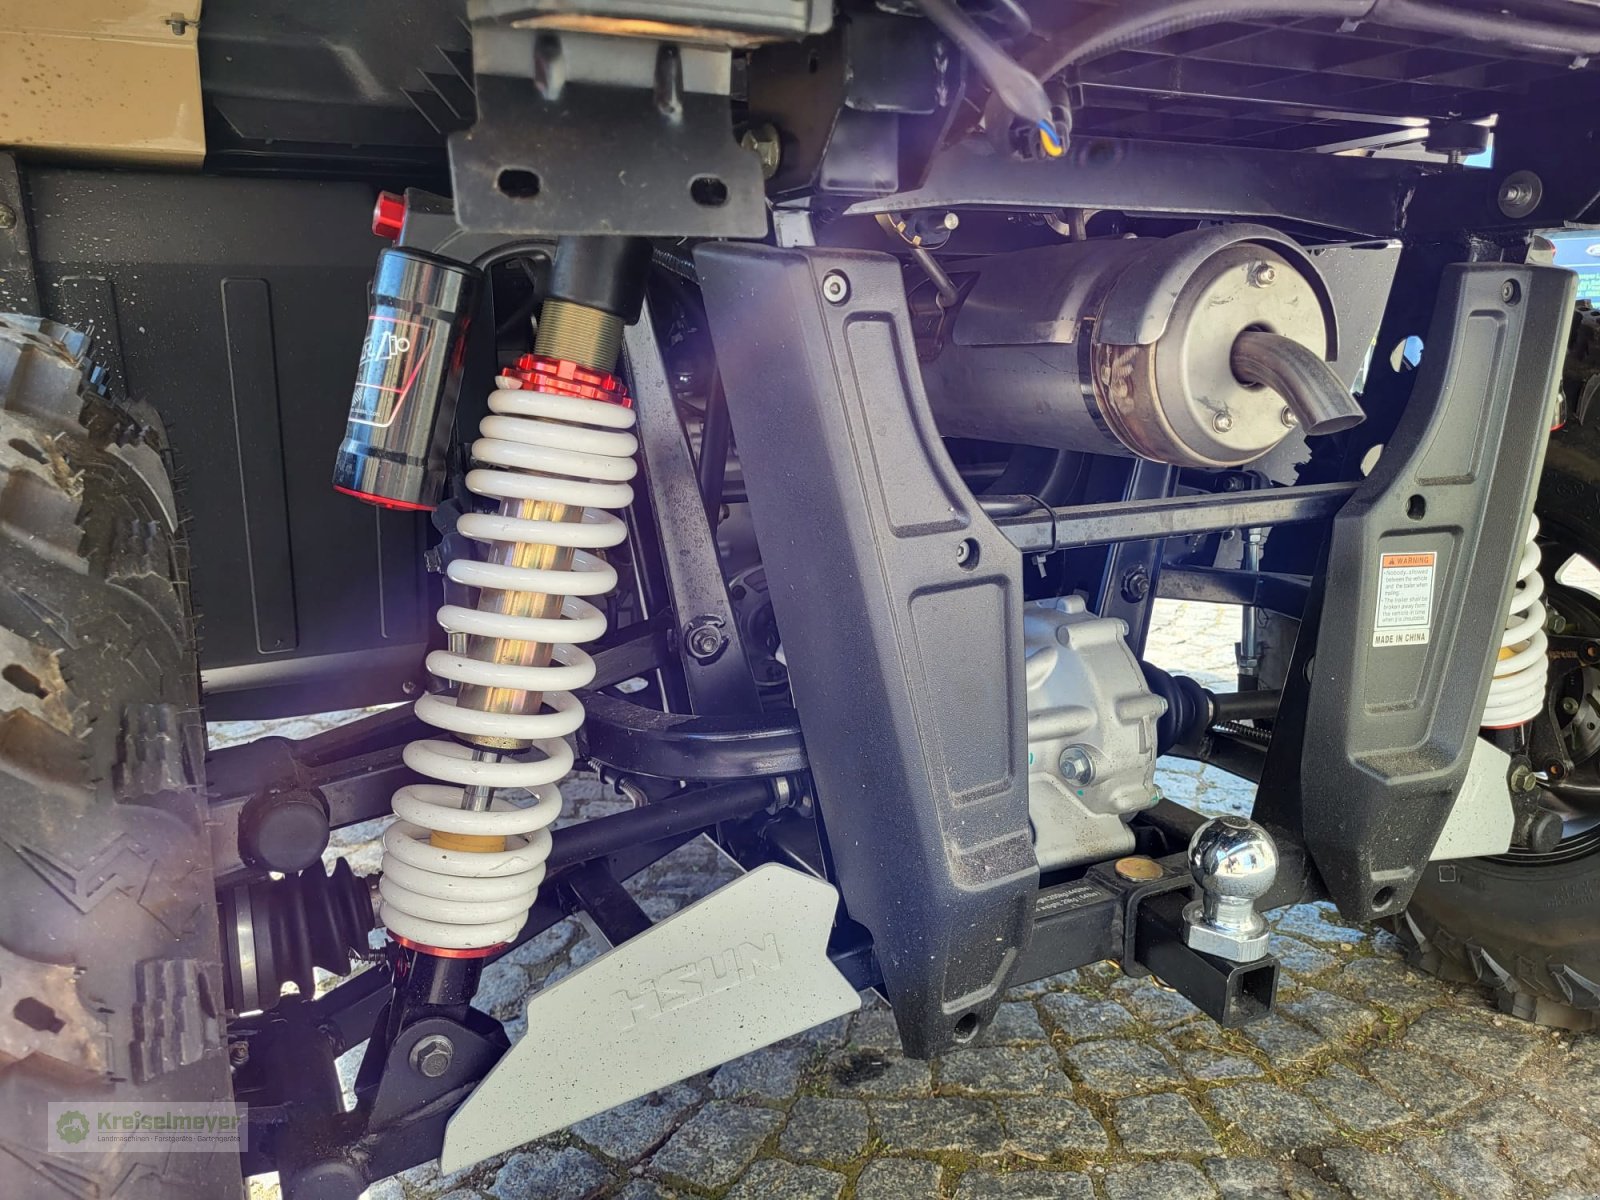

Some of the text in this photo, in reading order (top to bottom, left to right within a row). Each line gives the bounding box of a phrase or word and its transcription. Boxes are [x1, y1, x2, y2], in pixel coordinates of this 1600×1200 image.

[1397, 556, 1429, 565] WARNING
[1375, 632, 1426, 644] MADE IN CHINA
[609, 932, 782, 1034] HSUN
